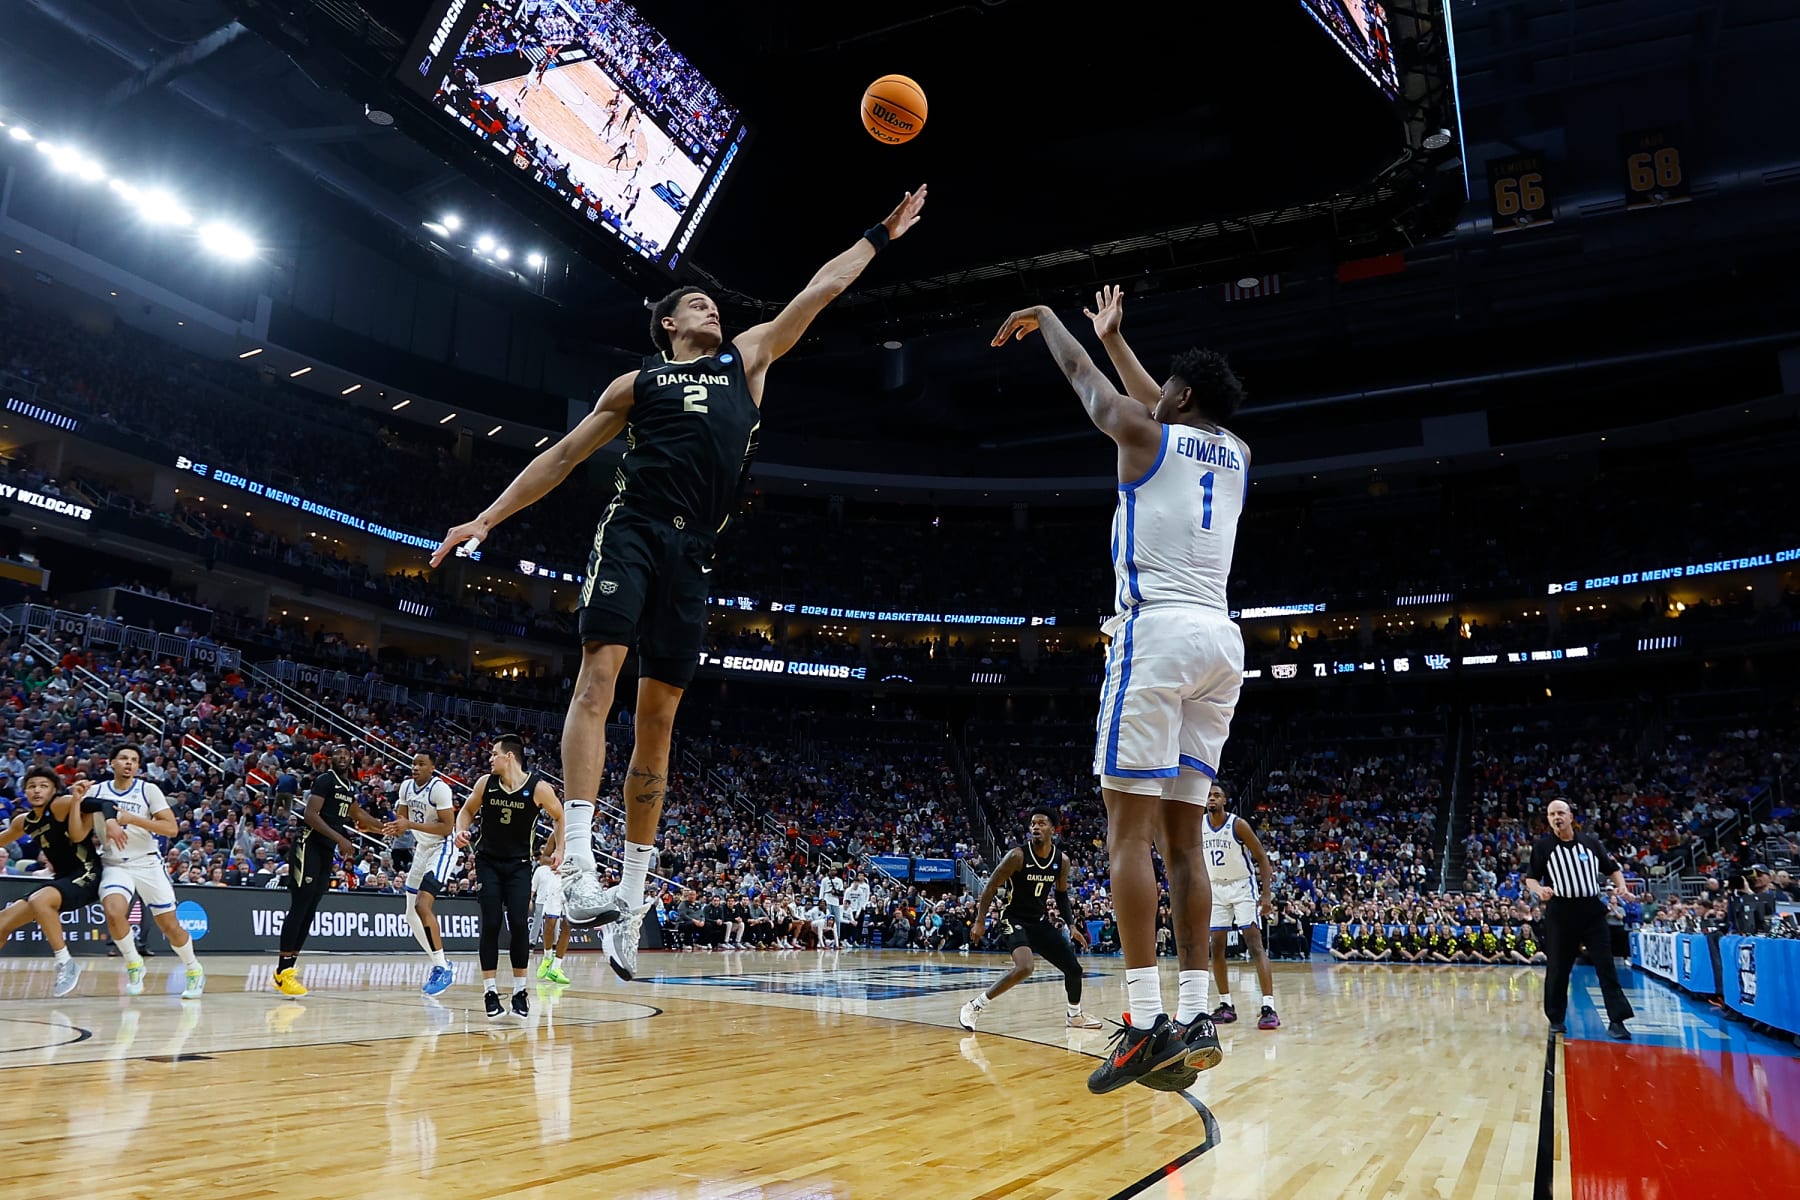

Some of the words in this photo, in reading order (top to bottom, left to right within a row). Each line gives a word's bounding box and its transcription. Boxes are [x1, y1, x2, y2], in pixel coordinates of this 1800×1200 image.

[873, 103, 913, 131] Wilson
[1627, 147, 1682, 192] 68
[677, 142, 738, 254] MARCHMADNESS
[1494, 172, 1545, 216] 66
[656, 373, 729, 386] OAKLAND
[683, 385, 708, 414] 2
[1176, 436, 1241, 471] EDWARDS
[17, 489, 92, 520] WILDCATS
[213, 469, 247, 489] 2024
[248, 481, 264, 495] DI
[265, 487, 300, 508] MEN'S
[301, 499, 366, 530] BASKETBALL
[1199, 471, 1215, 530] 1
[1585, 576, 1620, 589] 2024
[1622, 572, 1639, 584] DI
[1641, 567, 1683, 581] MEN'S
[1685, 553, 1773, 576] BASKETBALL
[801, 605, 829, 616] 2024
[830, 608, 843, 618] DI
[845, 610, 876, 622] MEN'S
[877, 612, 942, 623] BASKETBALL
[944, 614, 1026, 626] CHAMPIONSHIP
[1241, 603, 1315, 619] MARCHMADNESS
[59, 619, 86, 635] 103
[193, 648, 216, 663] 103
[1552, 650, 1563, 659] 10
[722, 656, 785, 673] SECOND
[787, 661, 851, 679] ROUNDS
[1313, 663, 1327, 677] 71
[1393, 658, 1410, 672] 65
[300, 671, 320, 685] 104
[338, 802, 349, 818] 10
[490, 798, 525, 809] OAKLAND
[500, 808, 512, 825] 3
[1210, 850, 1225, 866] 12
[1027, 874, 1055, 882] OAKLAND
[1034, 882, 1044, 897] 0
[252, 910, 289, 936] VIS
